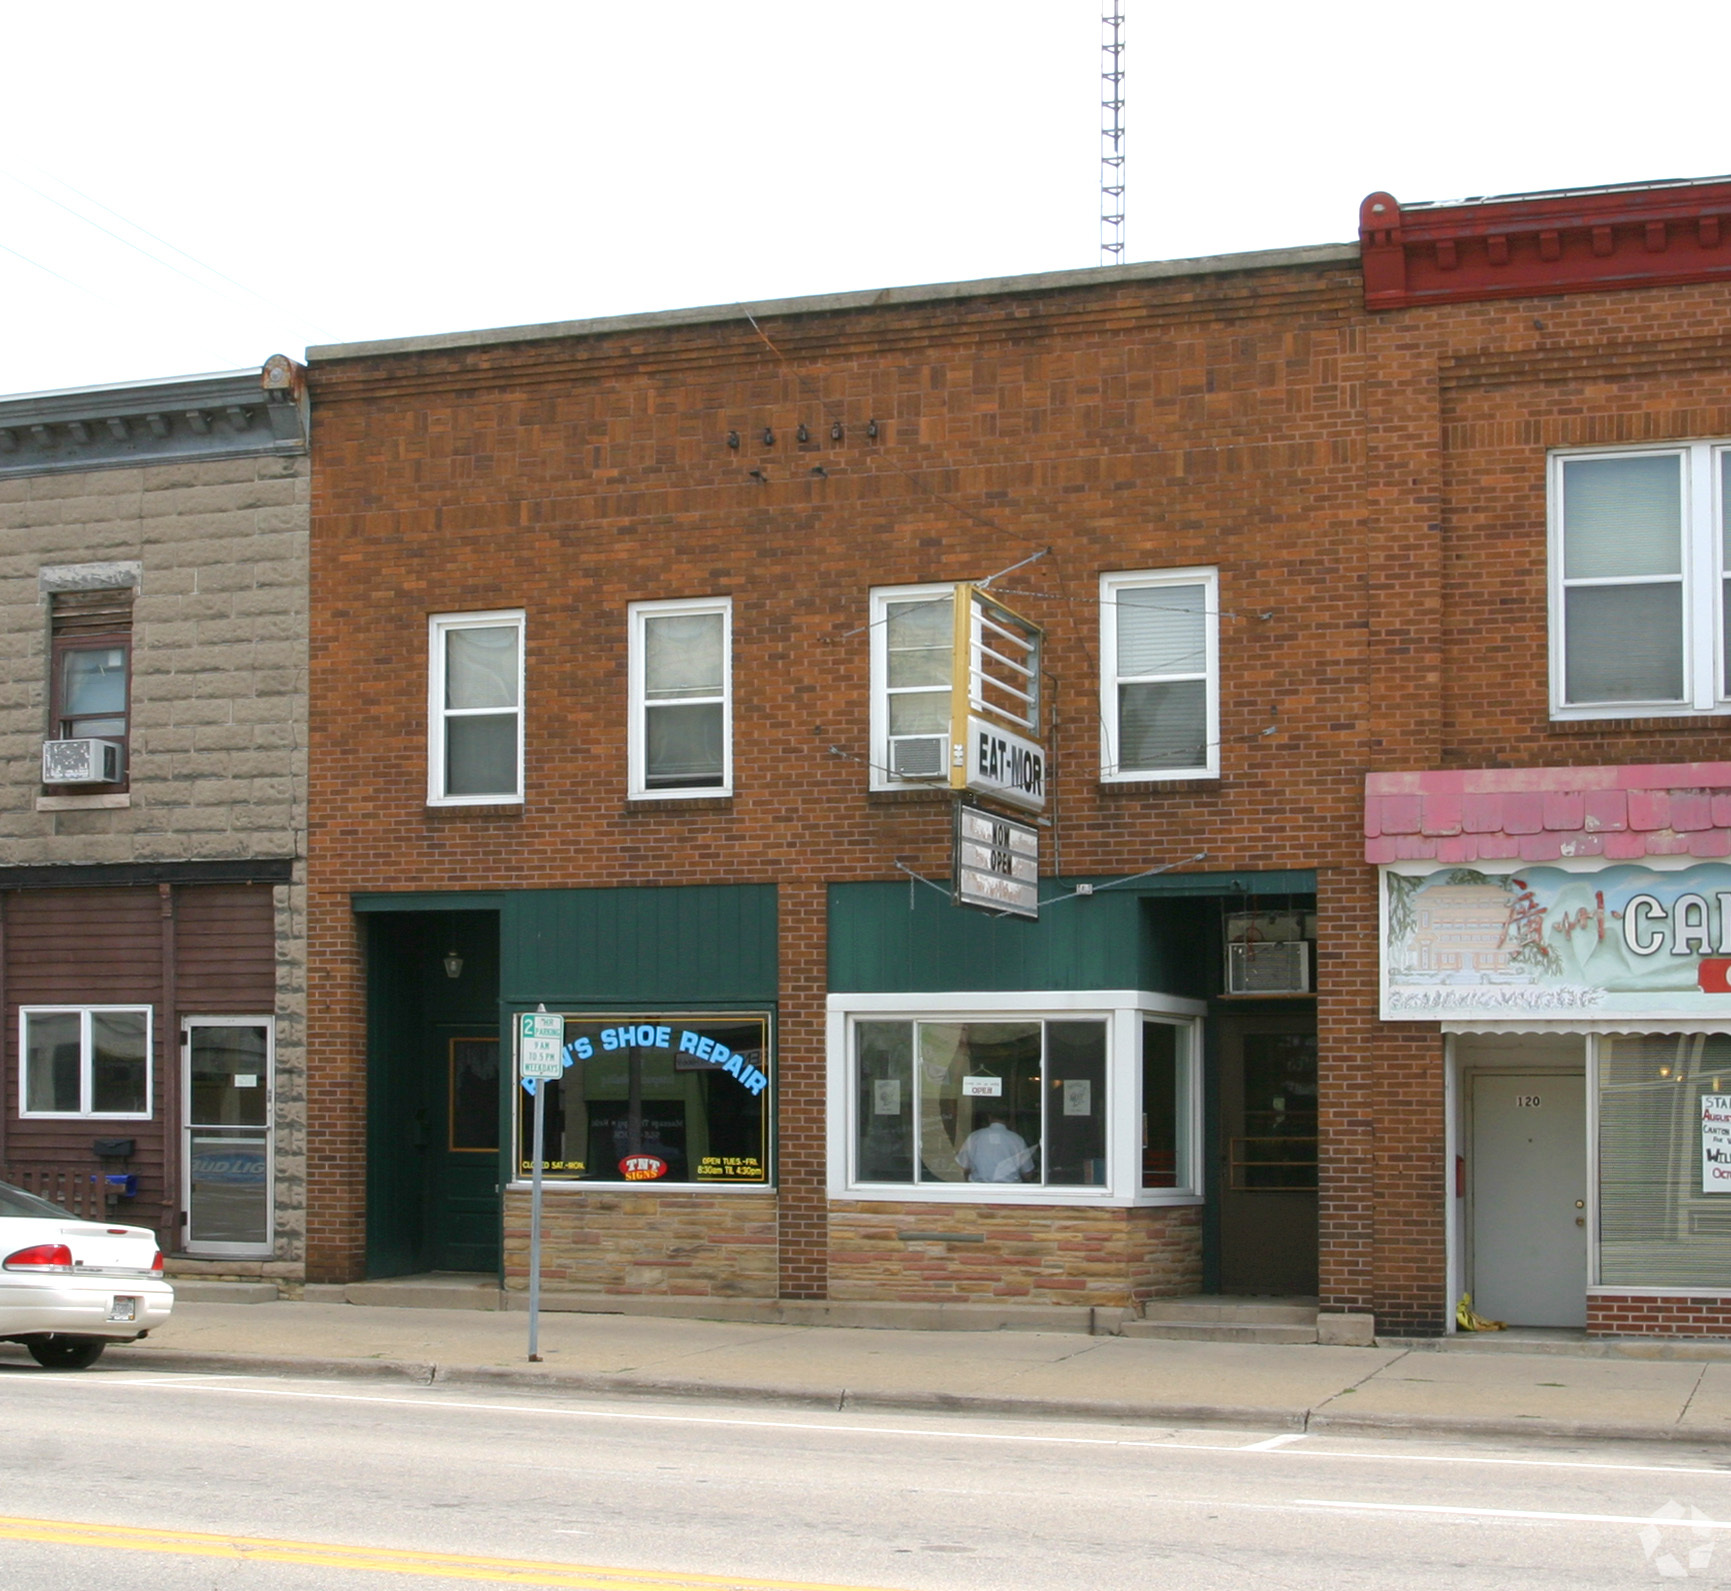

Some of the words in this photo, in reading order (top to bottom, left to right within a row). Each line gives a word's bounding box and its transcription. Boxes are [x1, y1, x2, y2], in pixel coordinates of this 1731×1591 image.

[979, 732, 1042, 797] EAT-MOR
[991, 849, 1012, 876] OPEN
[524, 1019, 533, 1035] 2
[535, 1028, 560, 1036] PARKING
[541, 1042, 550, 1050] AM
[529, 1052, 538, 1061] TO
[546, 1053, 555, 1061] PM
[600, 1025, 672, 1051] SHOE
[679, 1030, 768, 1097] REPAIR
[525, 1064, 558, 1072] WEEKDAYS
[971, 1086, 993, 1095] OPEN
[1518, 1096, 1540, 1107] 120
[1706, 1097, 1731, 1108] STA
[626, 1158, 660, 1172] TNT
[702, 1157, 721, 1165] OPEN
[625, 1170, 659, 1181] SIGNS
